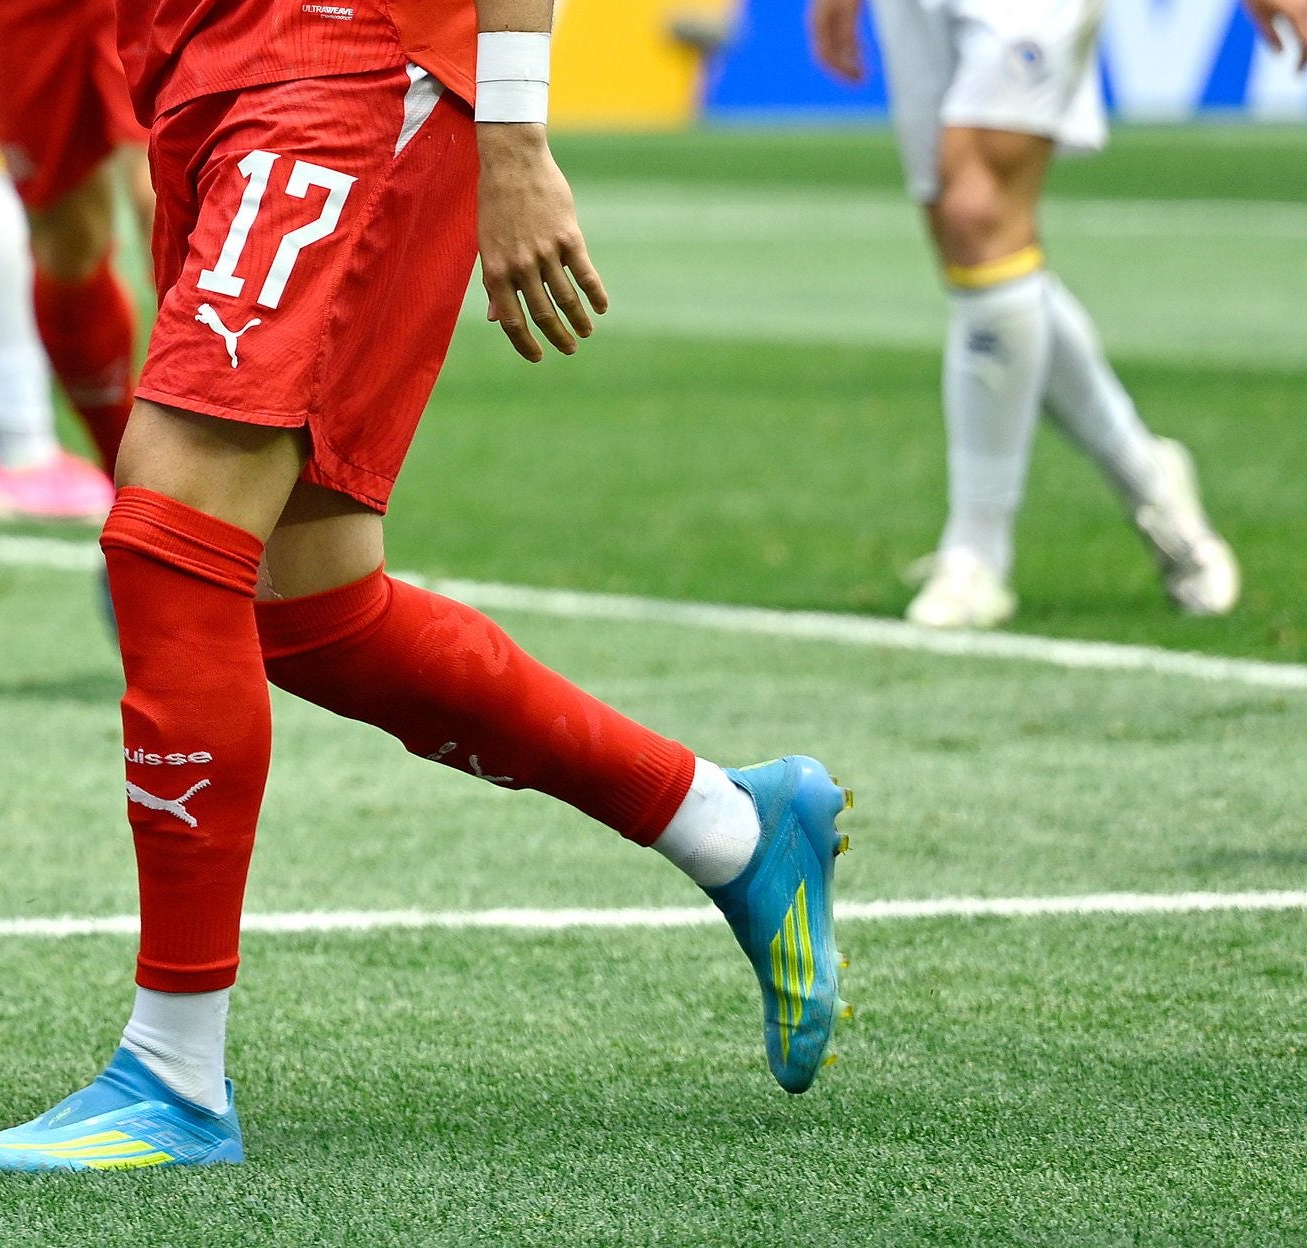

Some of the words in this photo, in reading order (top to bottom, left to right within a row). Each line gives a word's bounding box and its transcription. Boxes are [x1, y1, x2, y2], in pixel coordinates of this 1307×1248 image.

[302, 4, 354, 16] ULTRAWEAVE
[196, 149, 359, 309] 17
[122, 746, 213, 765] uisse
